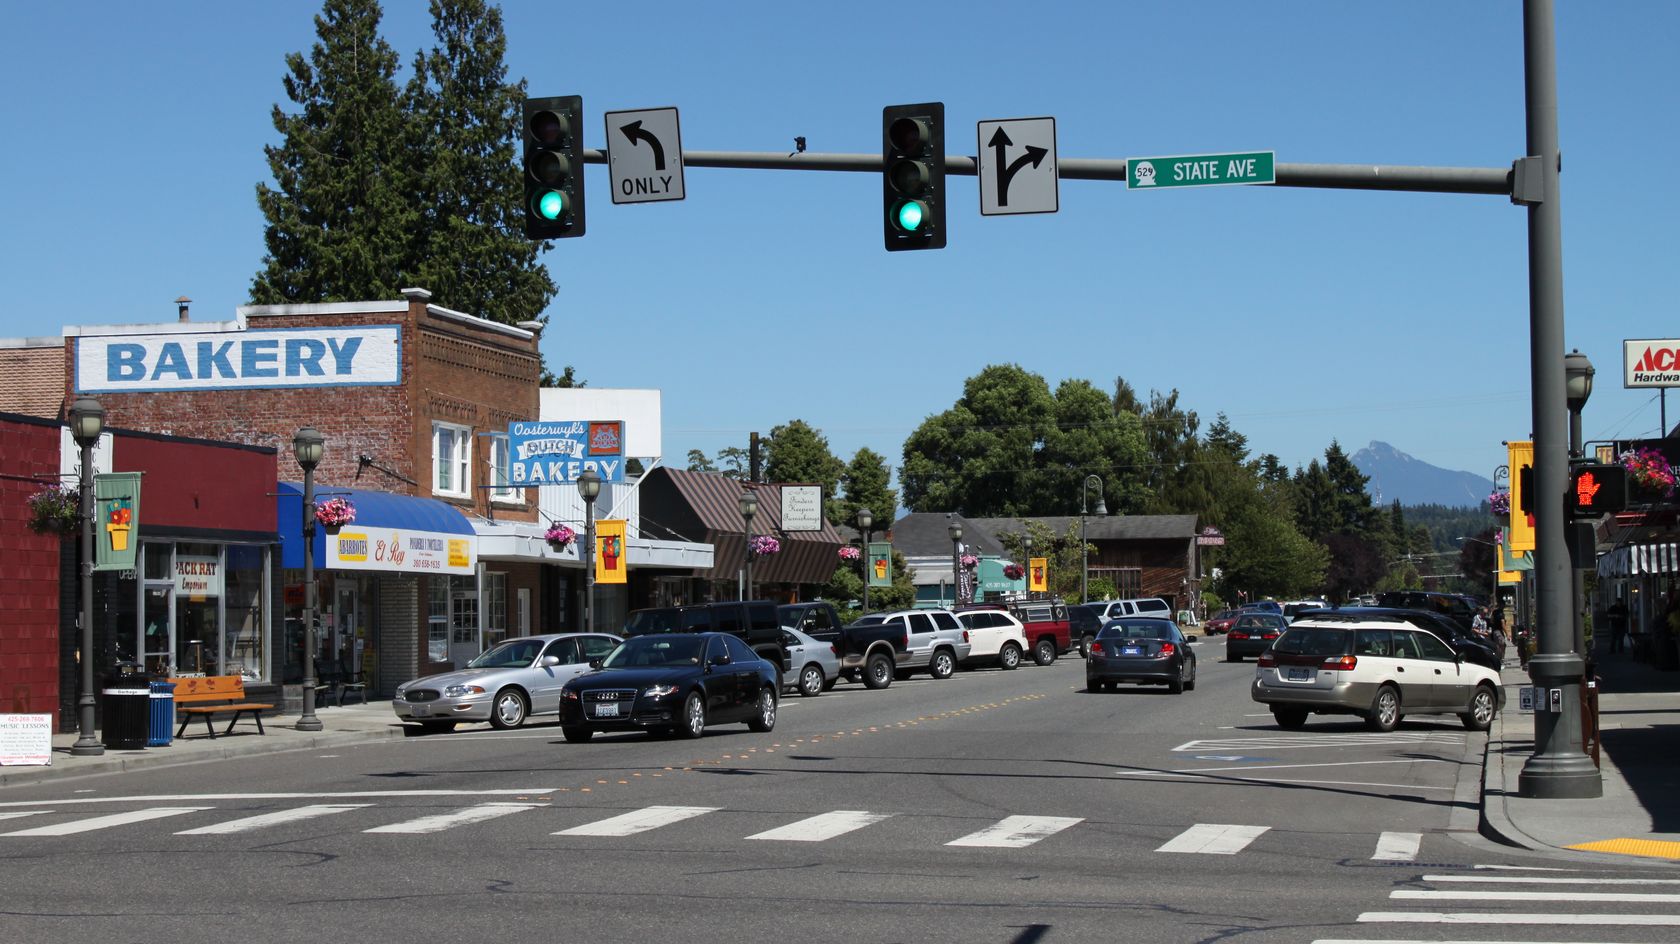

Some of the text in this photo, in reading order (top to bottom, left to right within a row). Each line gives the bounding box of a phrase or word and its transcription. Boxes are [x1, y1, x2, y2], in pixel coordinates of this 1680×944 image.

[1137, 167, 1153, 177] 529
[1173, 159, 1257, 181] STATE AVE
[622, 175, 672, 196] ONLY
[106, 337, 363, 381] BAKERY
[514, 422, 586, 438] Oosterwyk's
[527, 440, 575, 454] DUTCH
[340, 540, 367, 555] ABARROTES
[375, 540, 405, 565] El Rey
[199, 563, 216, 575] RAT
[182, 577, 207, 592] Emporium
